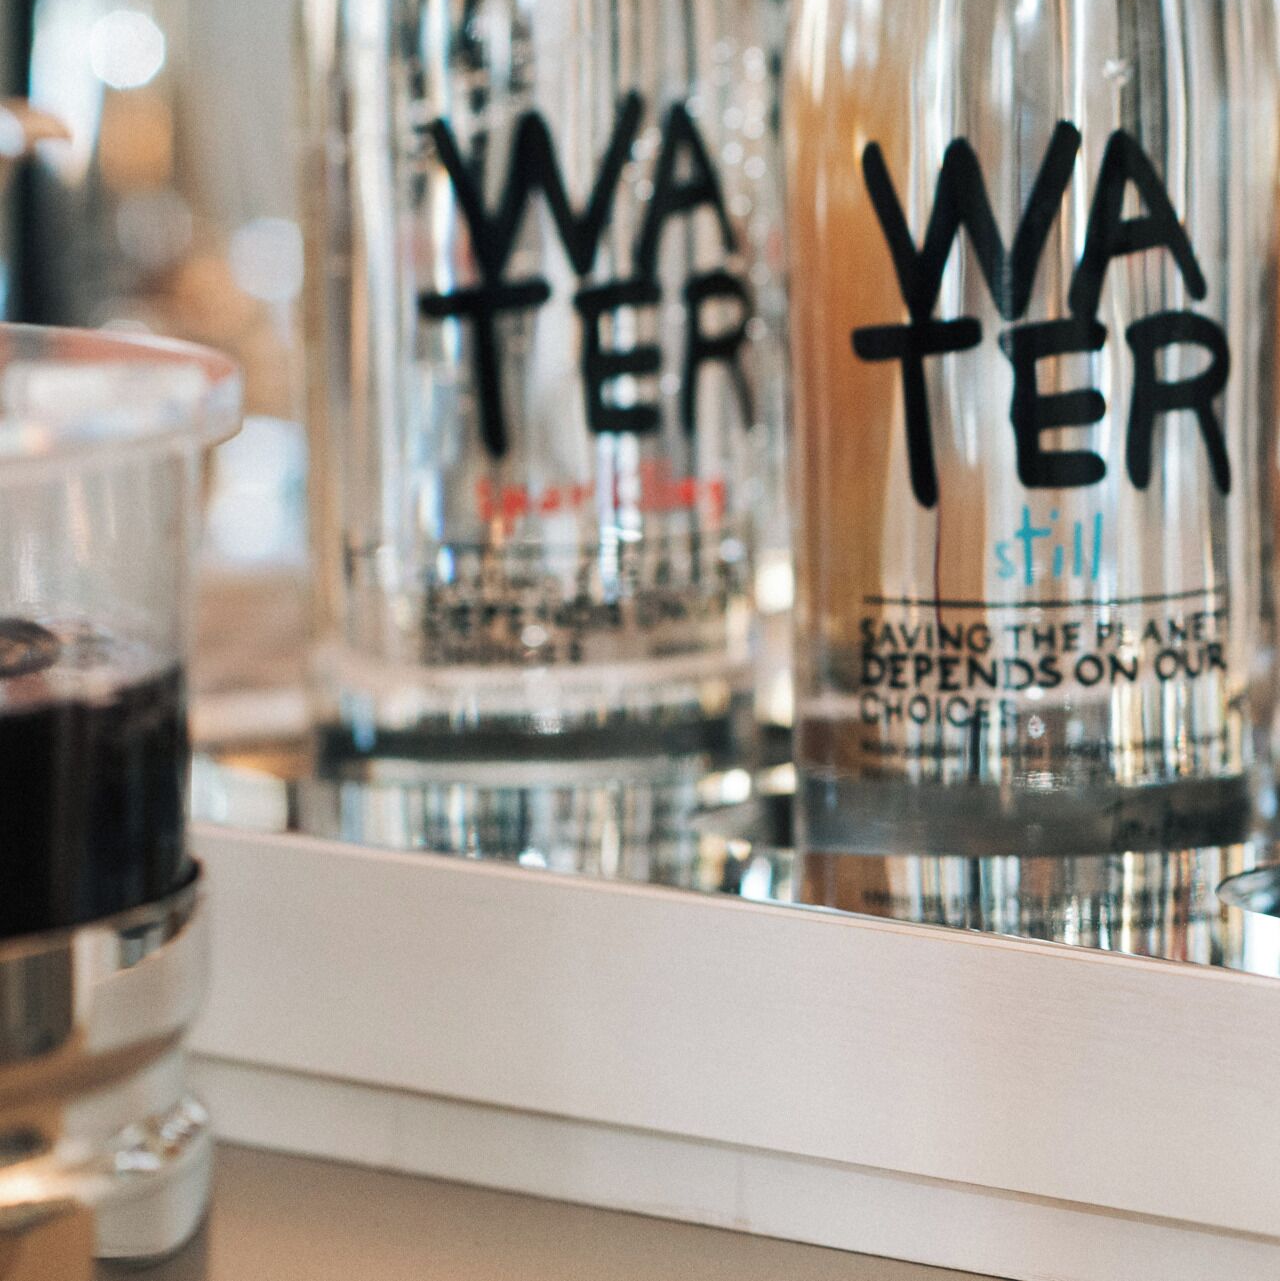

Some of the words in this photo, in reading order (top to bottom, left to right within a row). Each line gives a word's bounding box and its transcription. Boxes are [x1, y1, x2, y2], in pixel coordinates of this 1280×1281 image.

[432, 90, 738, 277] WA
[862, 120, 1207, 323] WA
[418, 267, 756, 460] TER
[851, 310, 1231, 510] TER
[994, 504, 1104, 586] still
[859, 616, 993, 655] SAVING
[1003, 620, 1082, 653] THE
[859, 650, 1064, 692] DEPENDS
[1074, 652, 1139, 686] ON
[1154, 641, 1229, 681] OUR
[859, 692, 1020, 730] CHOICES
